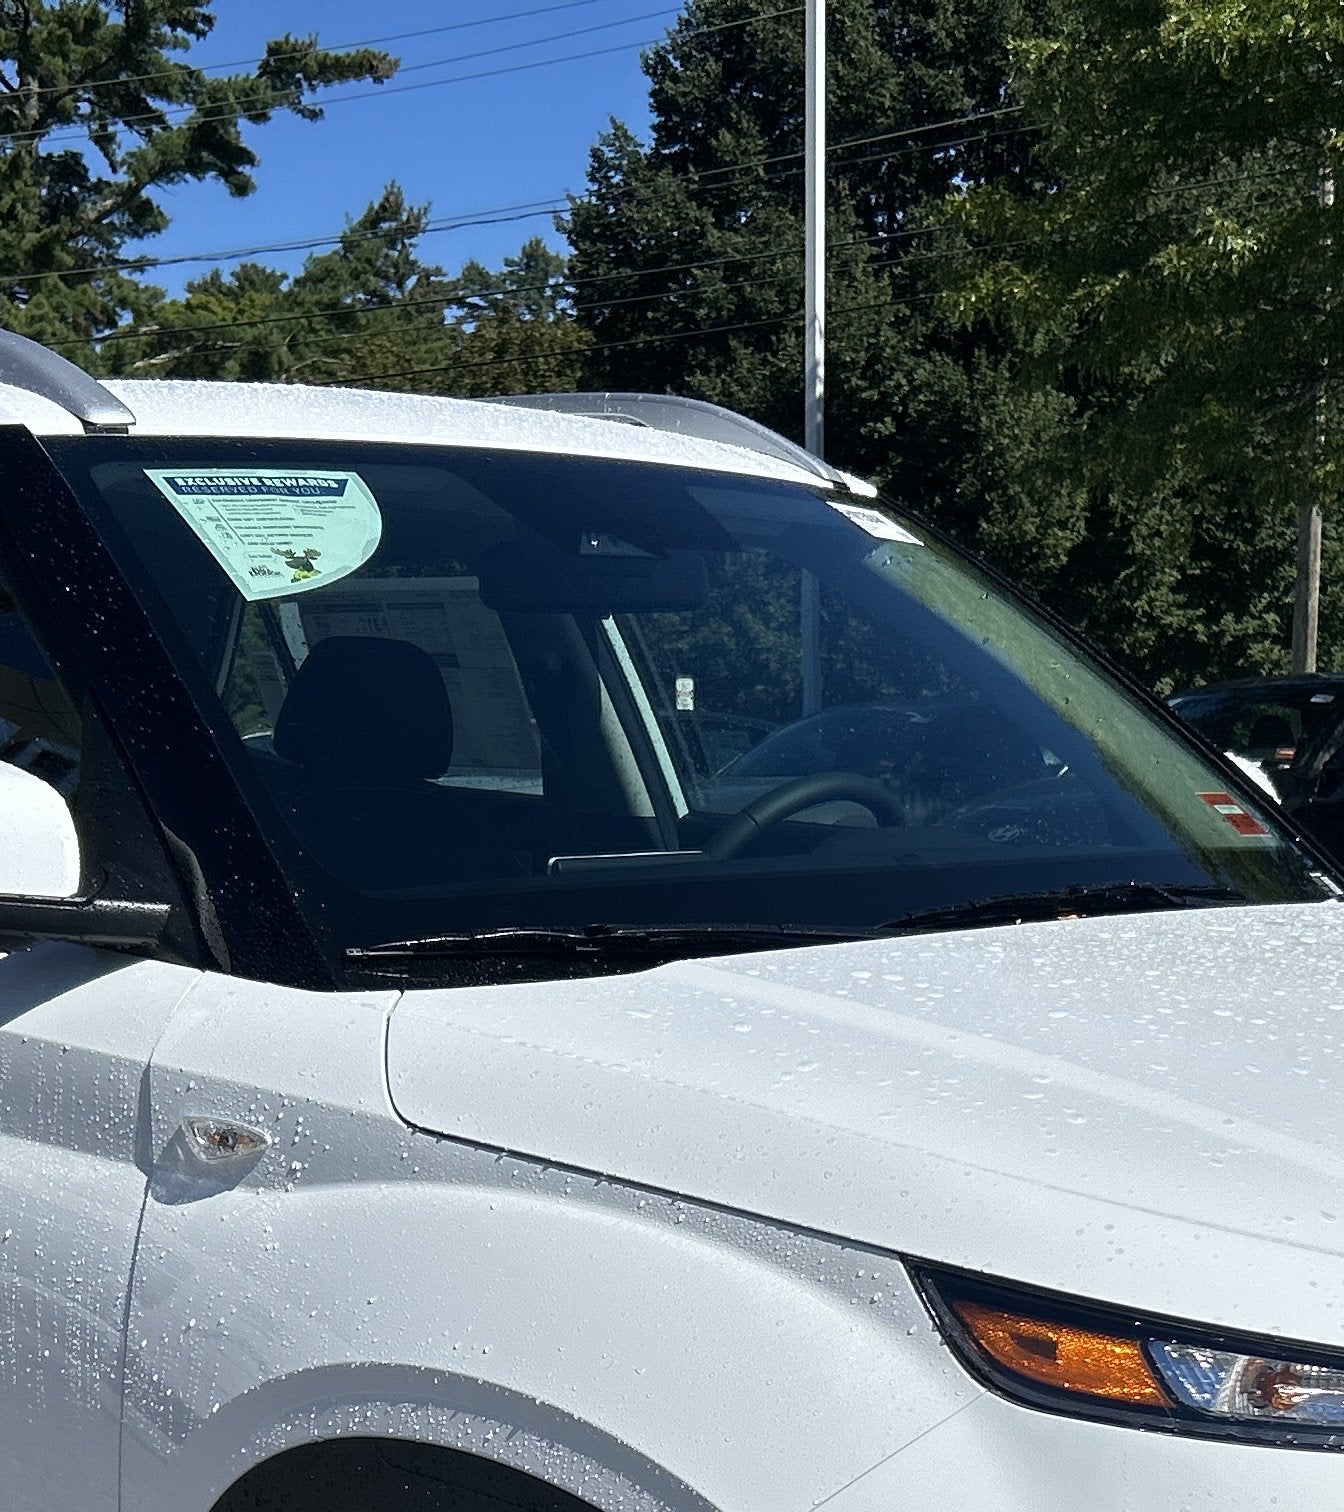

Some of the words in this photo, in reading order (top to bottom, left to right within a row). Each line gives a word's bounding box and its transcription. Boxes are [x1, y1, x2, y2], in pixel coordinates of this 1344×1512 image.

[174, 477, 262, 486] EXCLUSIVE
[262, 477, 339, 488] REWARDS
[181, 486, 257, 494] RESERVED
[261, 486, 290, 495] FOR
